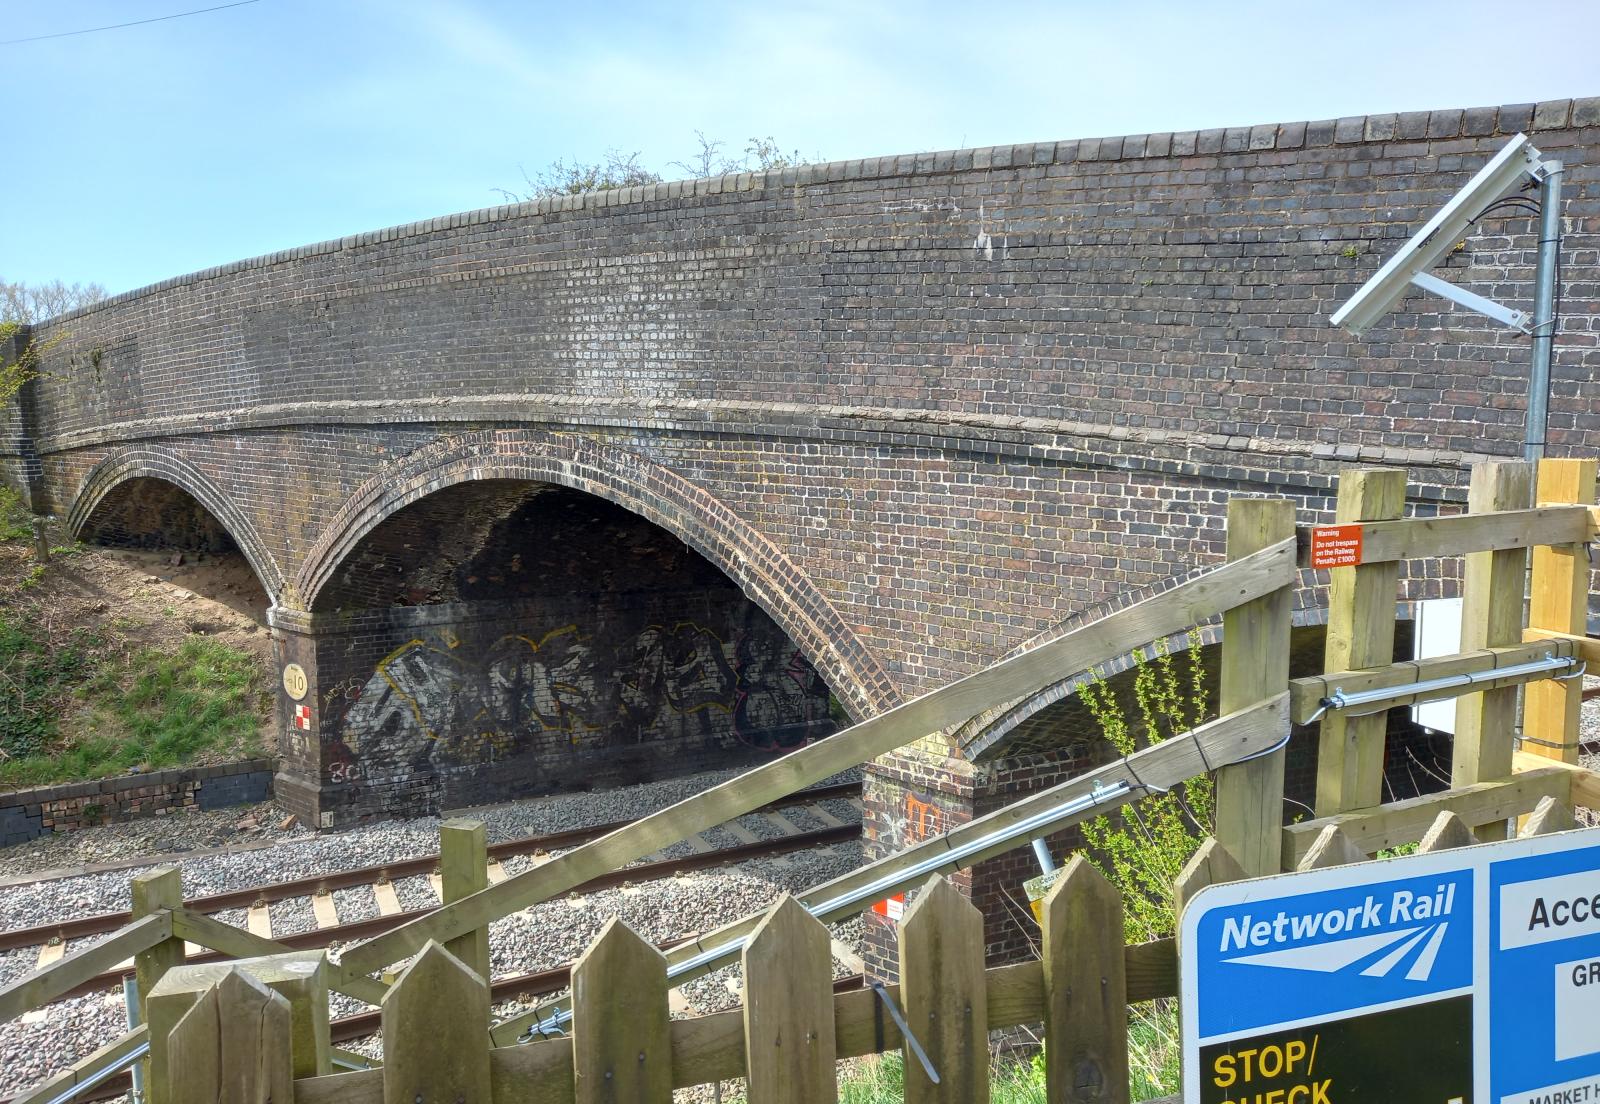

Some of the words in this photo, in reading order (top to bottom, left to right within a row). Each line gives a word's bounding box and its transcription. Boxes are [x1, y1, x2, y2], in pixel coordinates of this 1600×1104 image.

[1334, 547, 1355, 555] Railway
[1336, 539, 1358, 547] trespass
[294, 674, 303, 690] 10
[1220, 896, 1383, 952] Network
[1389, 882, 1456, 924] Rail
[1214, 1034, 1319, 1088] STOP/
